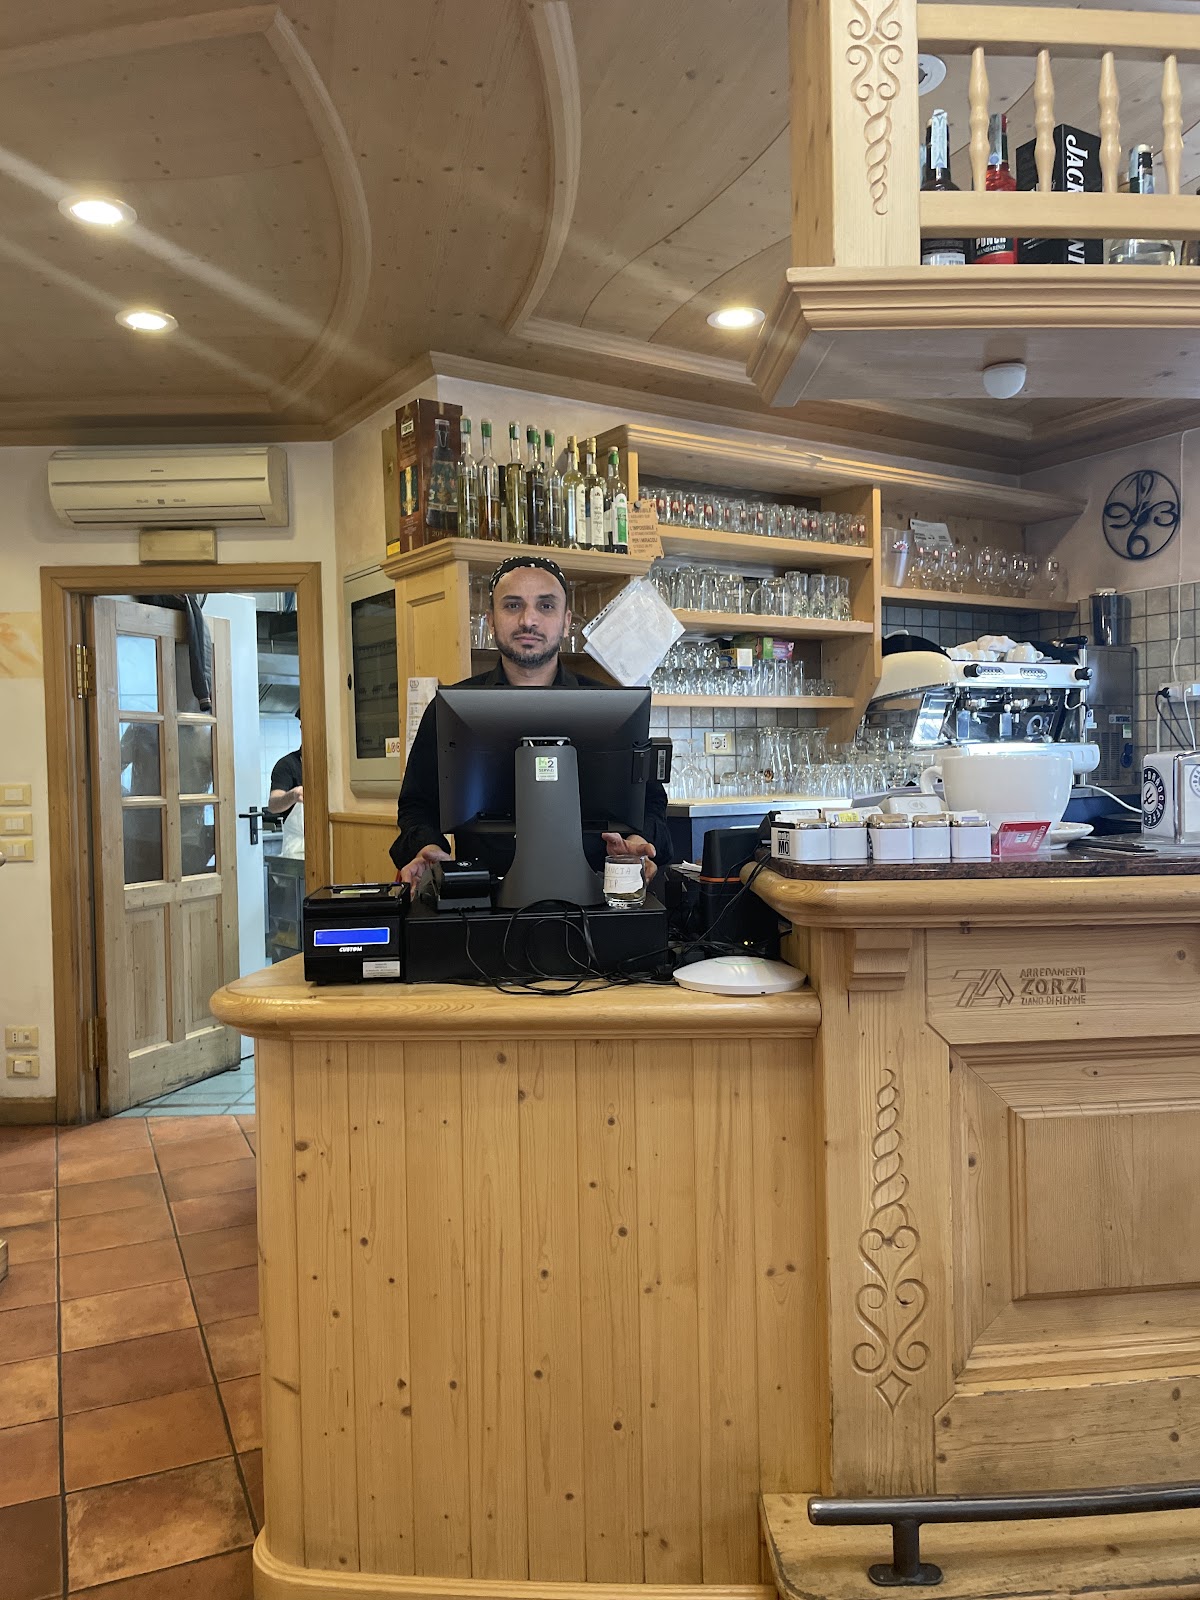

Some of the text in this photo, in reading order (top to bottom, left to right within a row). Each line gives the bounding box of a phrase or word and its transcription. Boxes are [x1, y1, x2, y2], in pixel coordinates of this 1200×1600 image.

[1066, 134, 1088, 192] JAC
[1020, 966, 1086, 978] ARREDAMENTI
[1021, 977, 1087, 995] ZORZI
